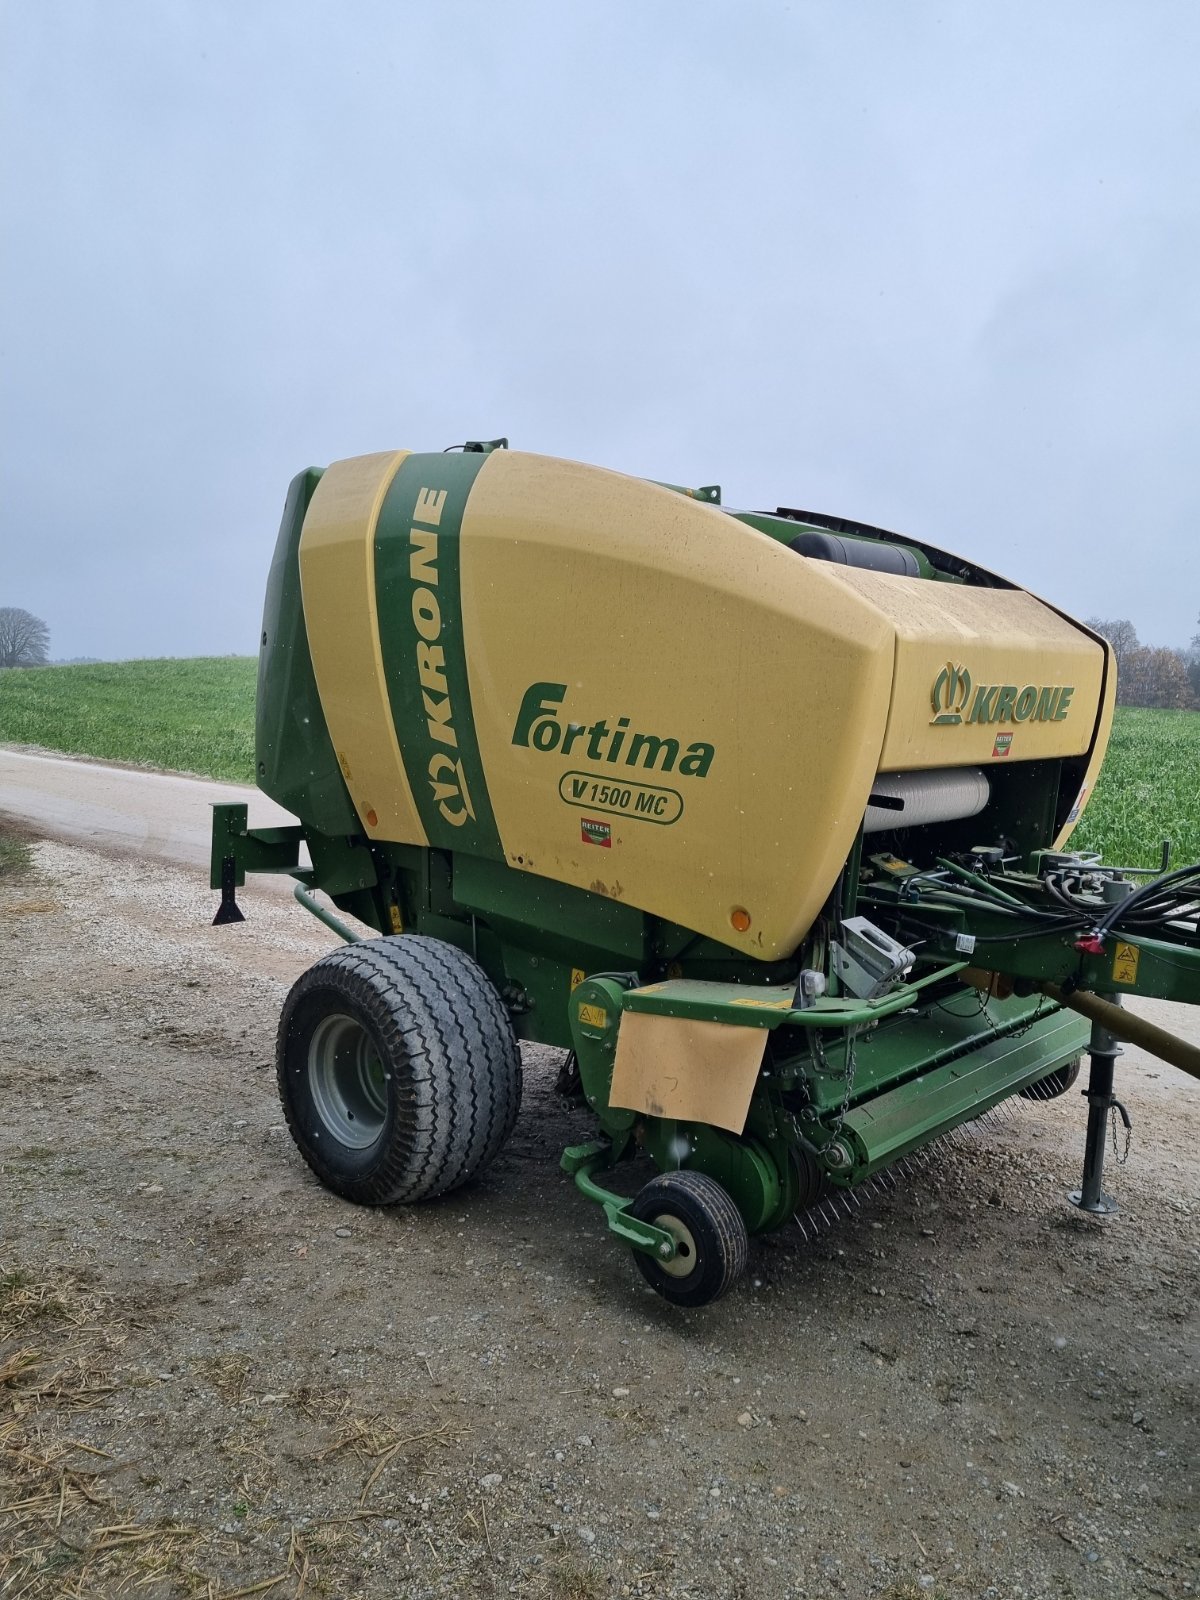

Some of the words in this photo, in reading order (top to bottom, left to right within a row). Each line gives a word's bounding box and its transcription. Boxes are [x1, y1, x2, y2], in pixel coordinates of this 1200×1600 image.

[410, 487, 458, 748] KRONE
[967, 684, 1075, 723] KRONE
[511, 682, 715, 778] Fortima
[572, 779, 588, 799] V
[590, 783, 631, 809] 1500
[634, 792, 668, 816] MC
[582, 821, 610, 833] REITER
